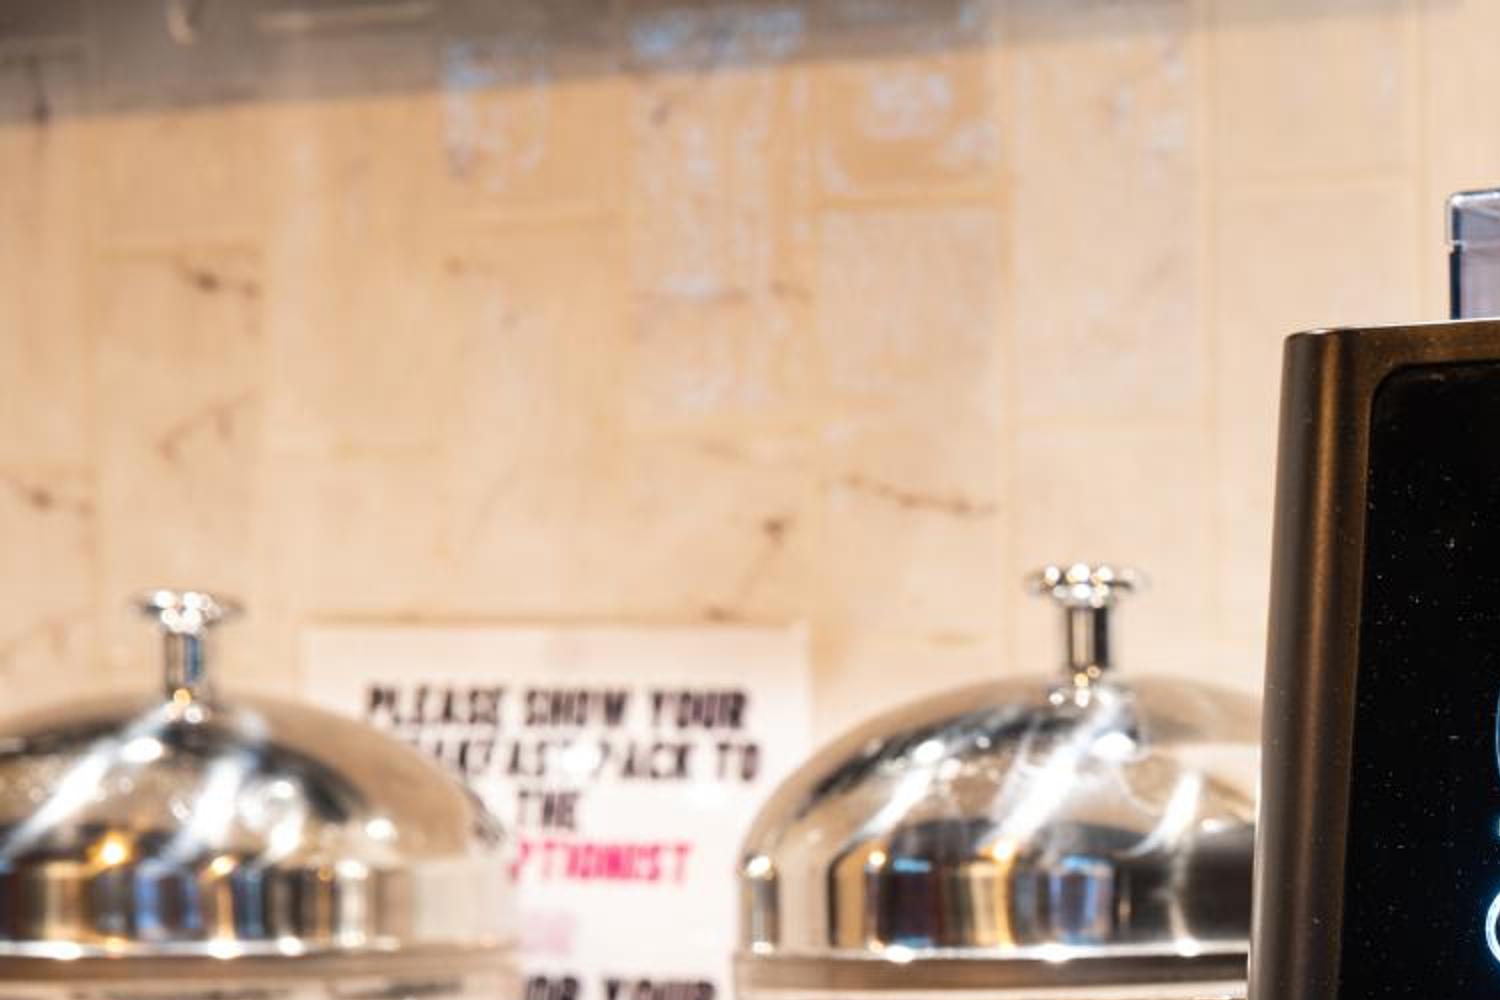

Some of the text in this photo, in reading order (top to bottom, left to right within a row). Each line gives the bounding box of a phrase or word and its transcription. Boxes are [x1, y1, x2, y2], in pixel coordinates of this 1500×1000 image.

[367, 685, 750, 730] PLEASE SHOW YOUR
[517, 789, 582, 831] THE
